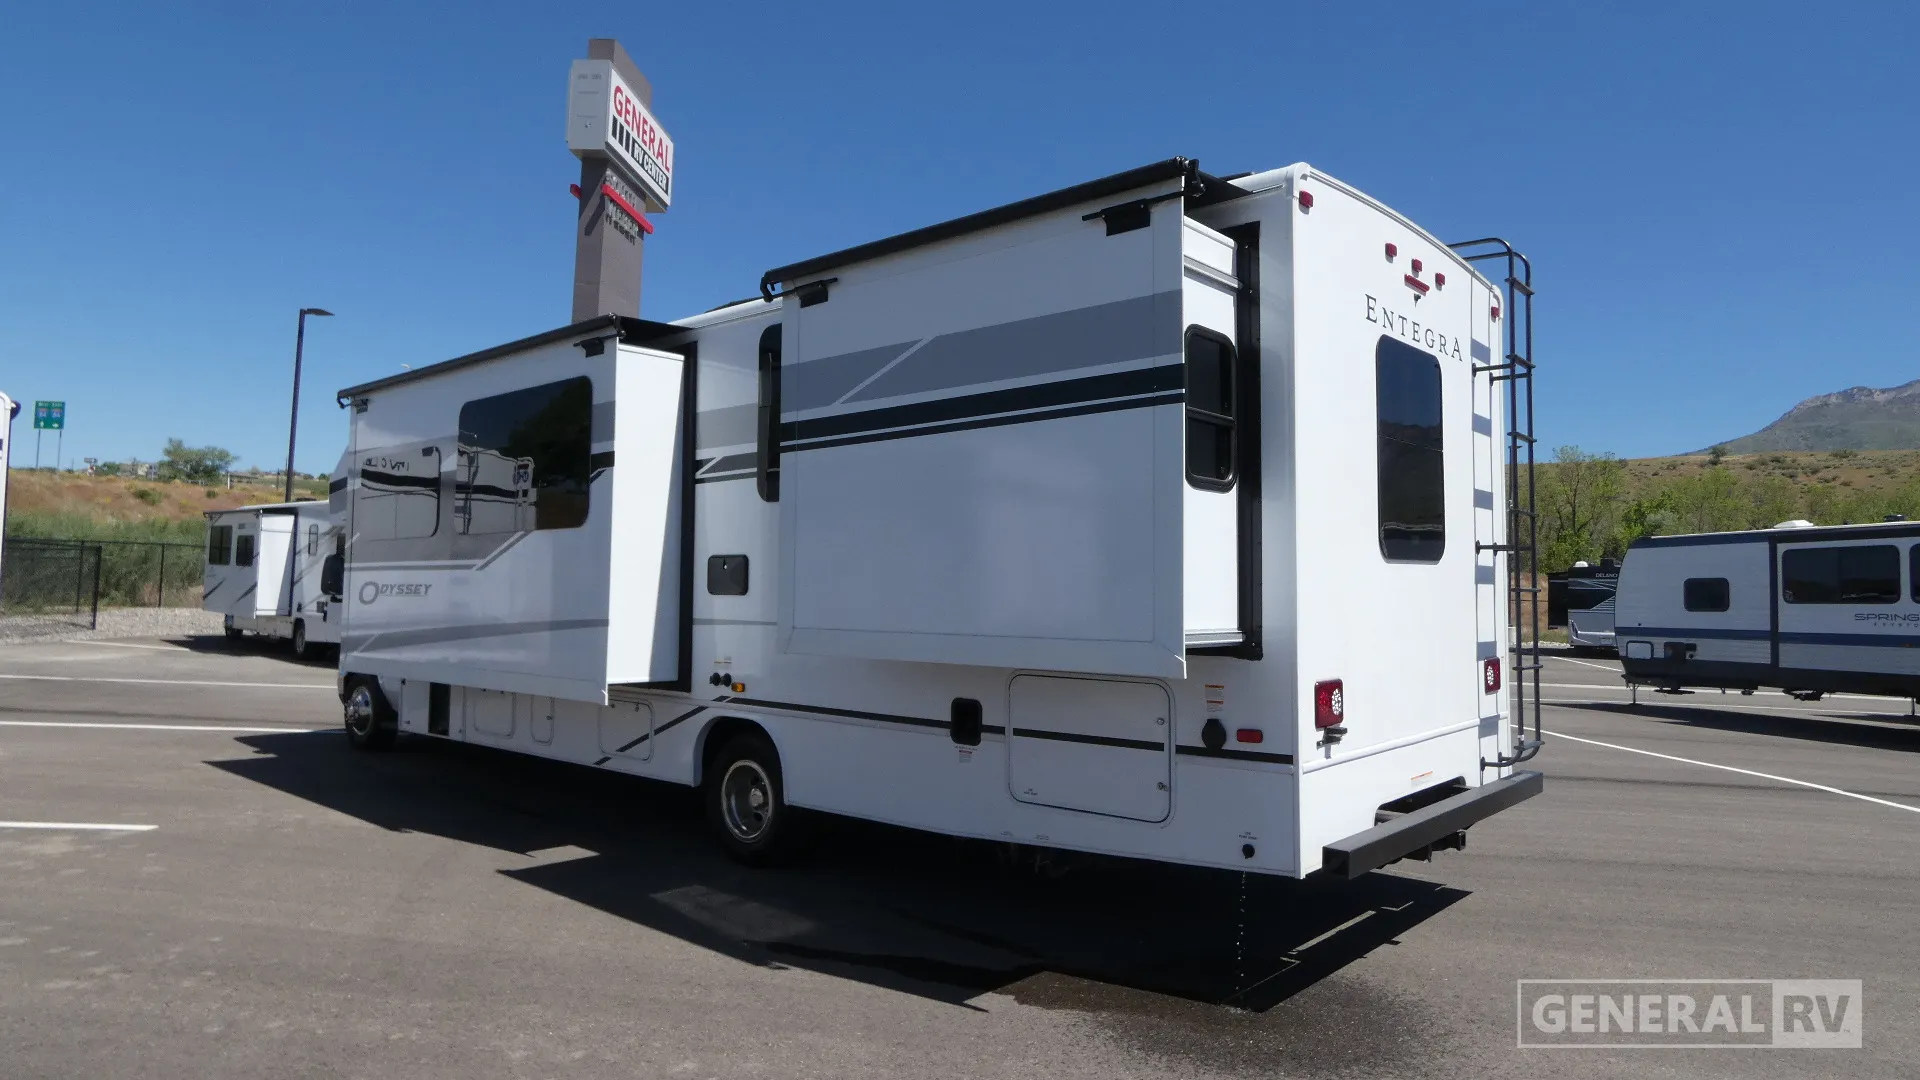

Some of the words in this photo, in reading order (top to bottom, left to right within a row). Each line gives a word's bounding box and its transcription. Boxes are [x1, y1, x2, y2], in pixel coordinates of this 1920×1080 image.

[613, 86, 670, 173] GENERAL
[633, 142, 644, 165] RV
[643, 154, 667, 192] CENTER
[1365, 293, 1463, 362] ENTEGRA
[358, 581, 432, 605] ODYSSEY
[1854, 613, 1920, 621] SPRING
